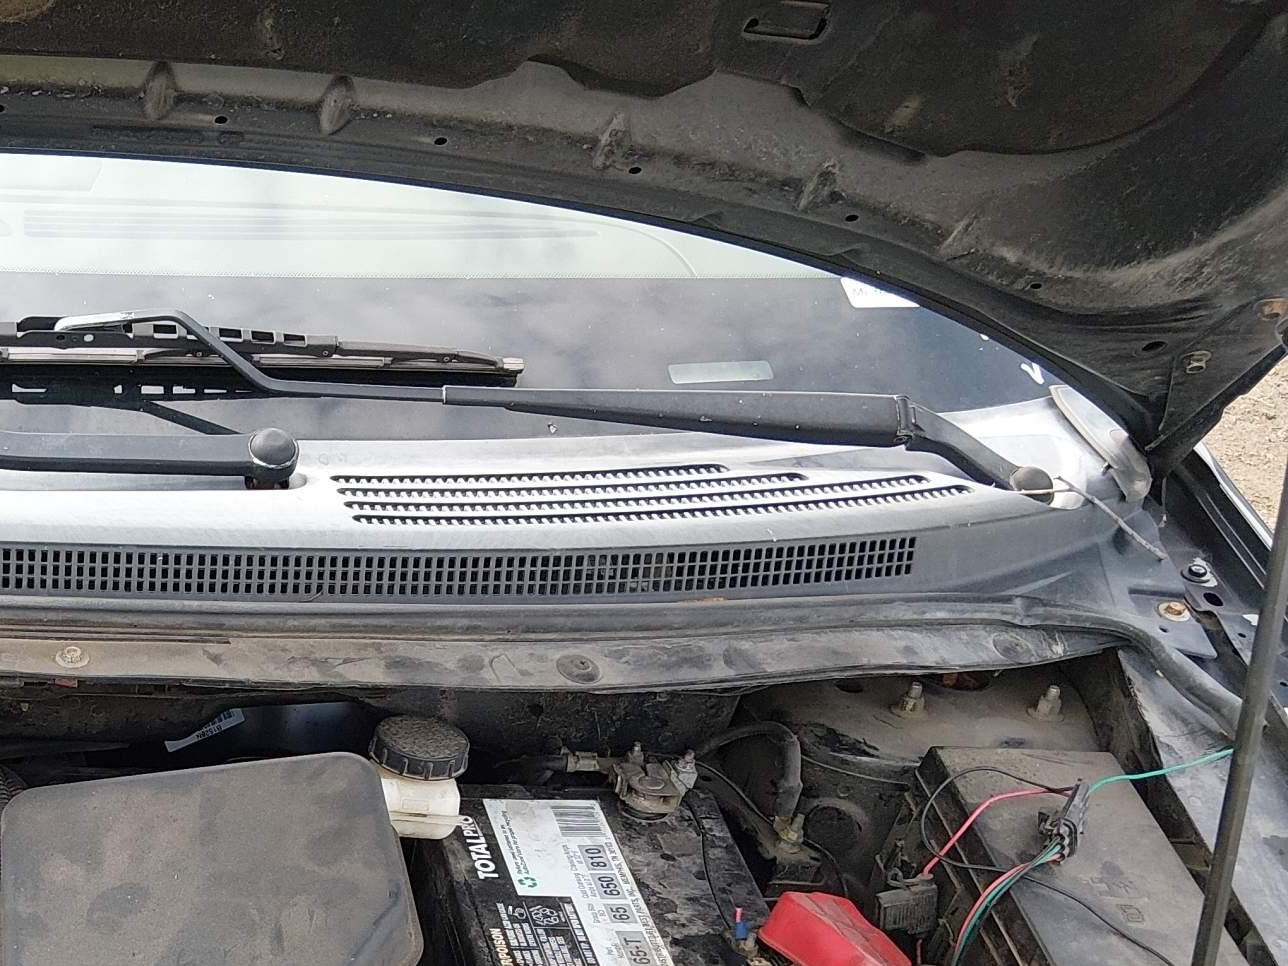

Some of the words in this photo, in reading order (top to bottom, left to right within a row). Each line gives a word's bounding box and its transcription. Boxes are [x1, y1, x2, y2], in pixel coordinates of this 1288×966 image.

[462, 816, 499, 879] TOTALPRO
[585, 848, 607, 868] 810
[598, 876, 621, 896] 650
[610, 907, 631, 921] 65
[623, 937, 651, 965] 65-T
